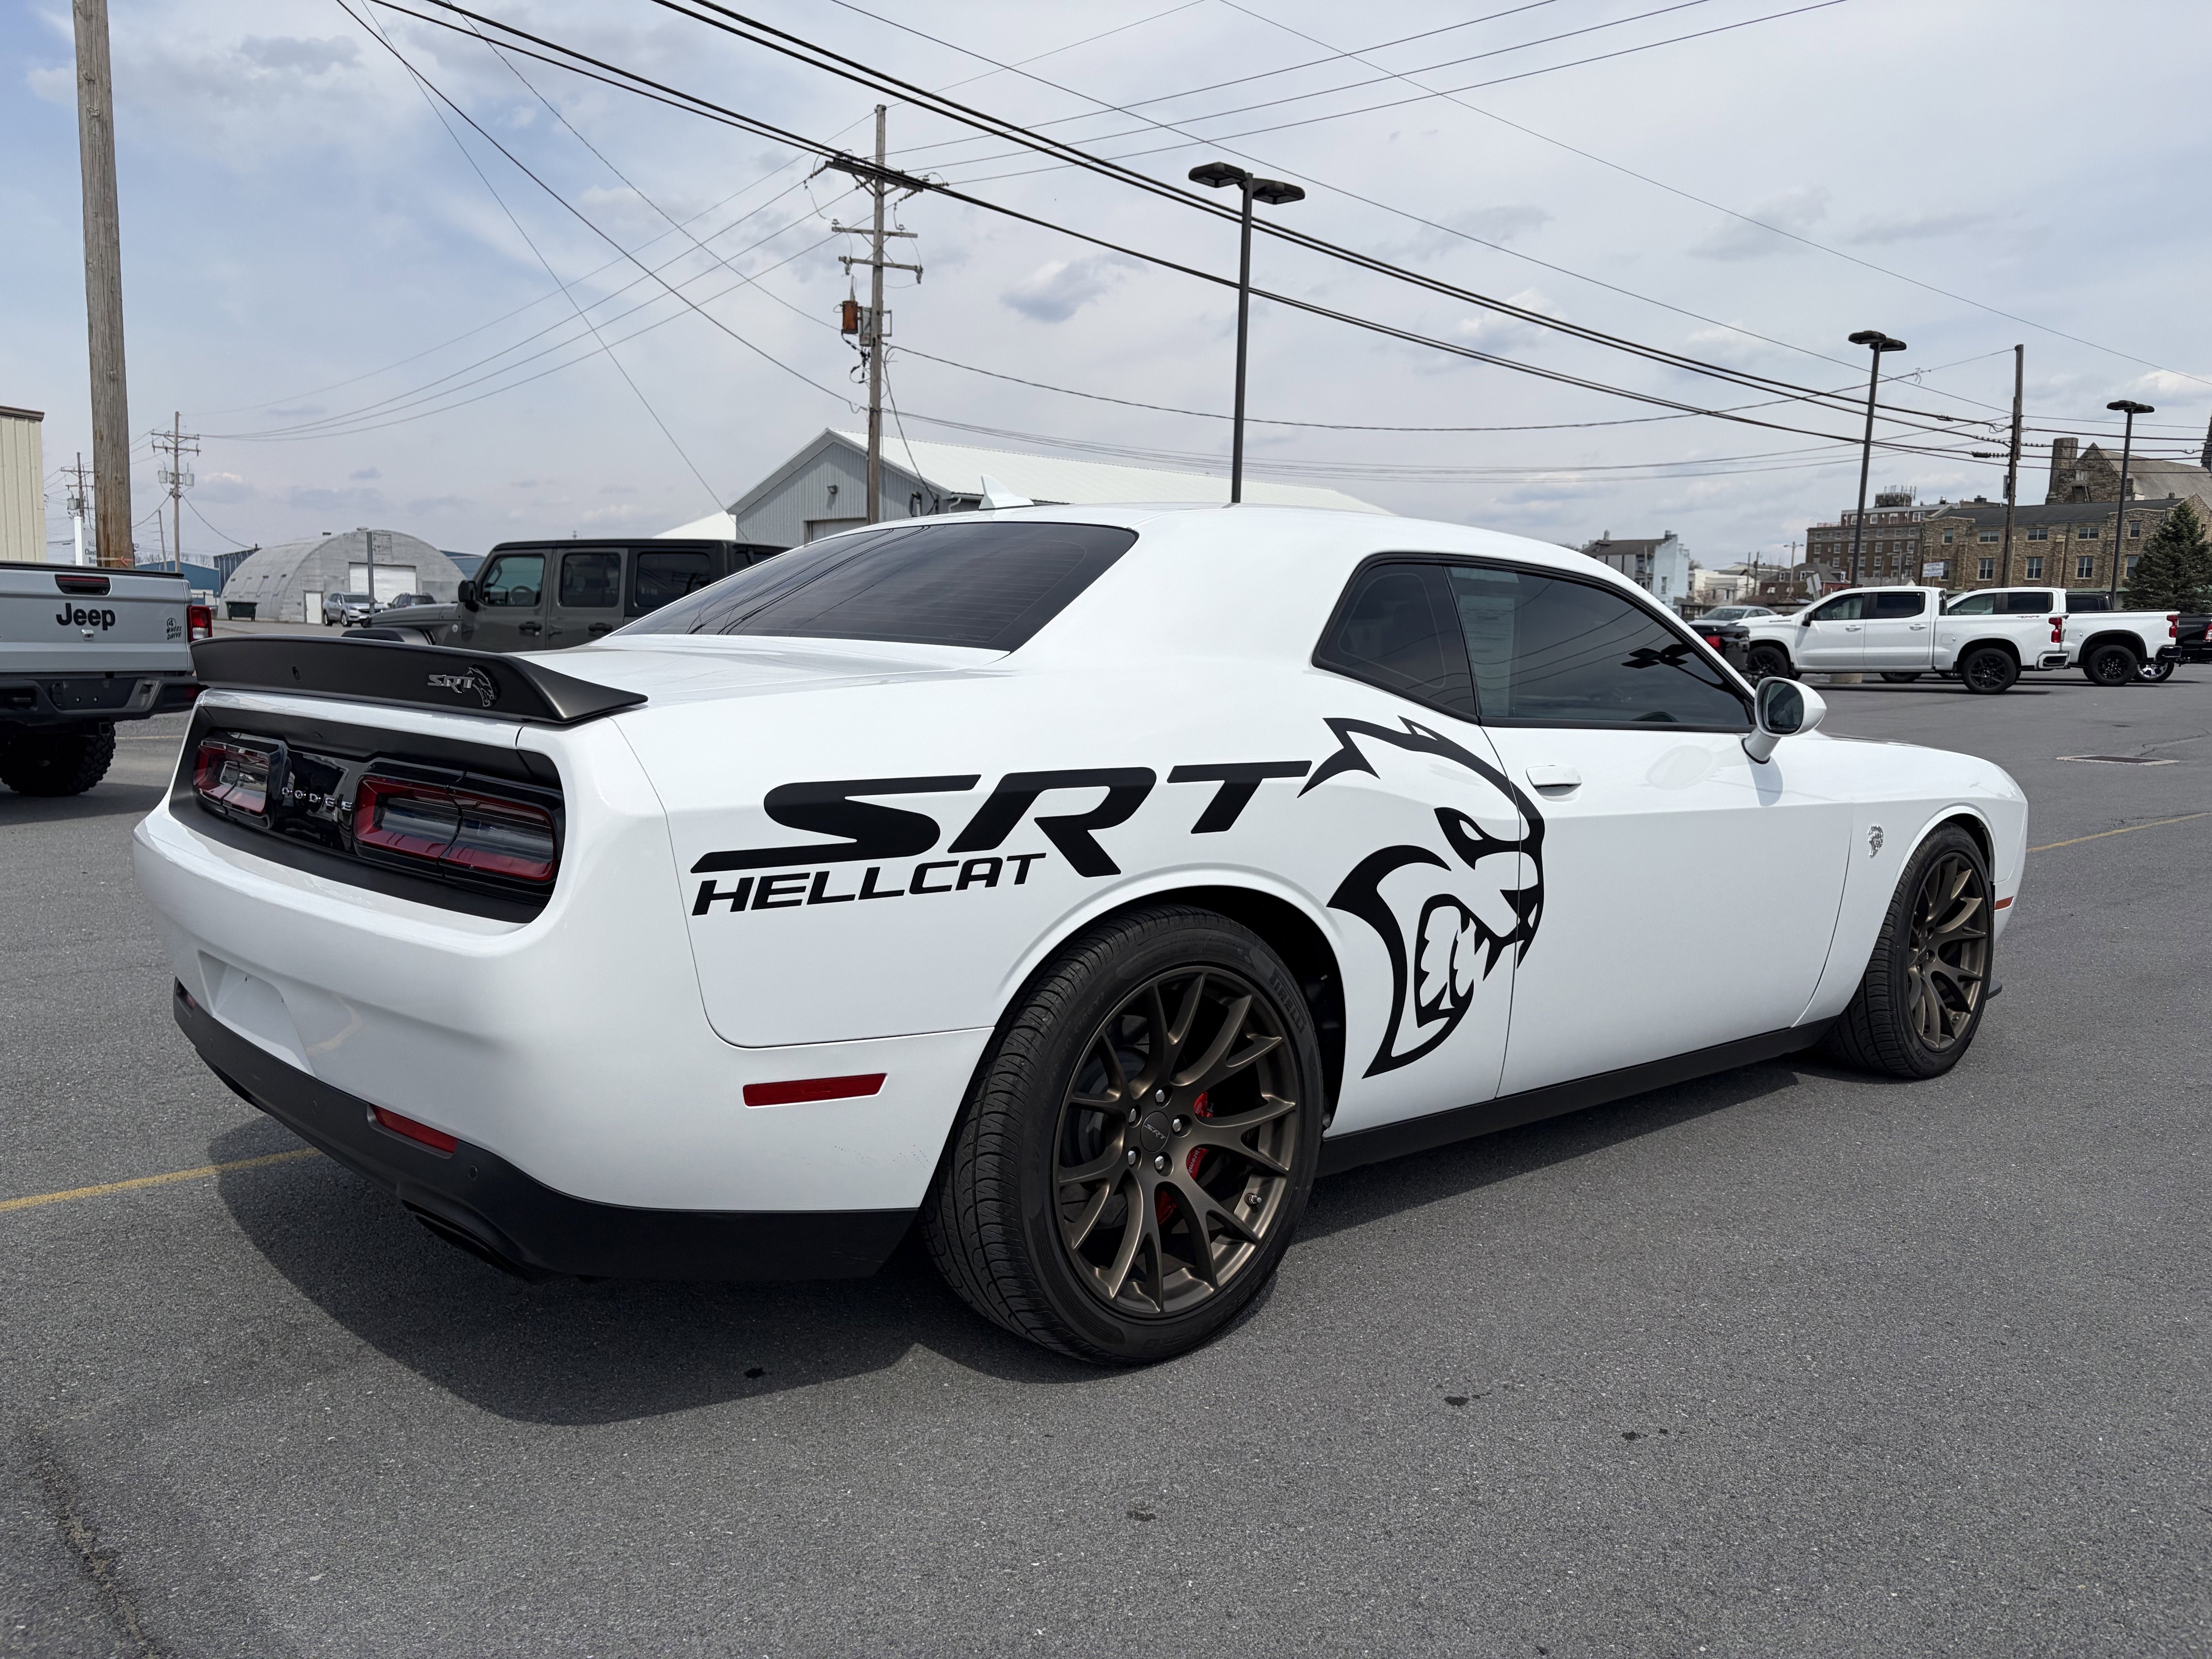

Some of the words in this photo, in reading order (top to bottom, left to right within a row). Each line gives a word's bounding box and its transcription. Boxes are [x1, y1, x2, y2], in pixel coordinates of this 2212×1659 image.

[56, 603, 115, 630] Jeep
[428, 675, 475, 693] SRT
[282, 787, 352, 811] DODGE
[690, 760, 1312, 878] SRT
[692, 853, 1046, 916] HELLCAT
[1269, 968, 1306, 1034] PIRELLI
[1144, 1124, 1166, 1139] SRT
[1188, 1150, 1200, 1174] bremb
